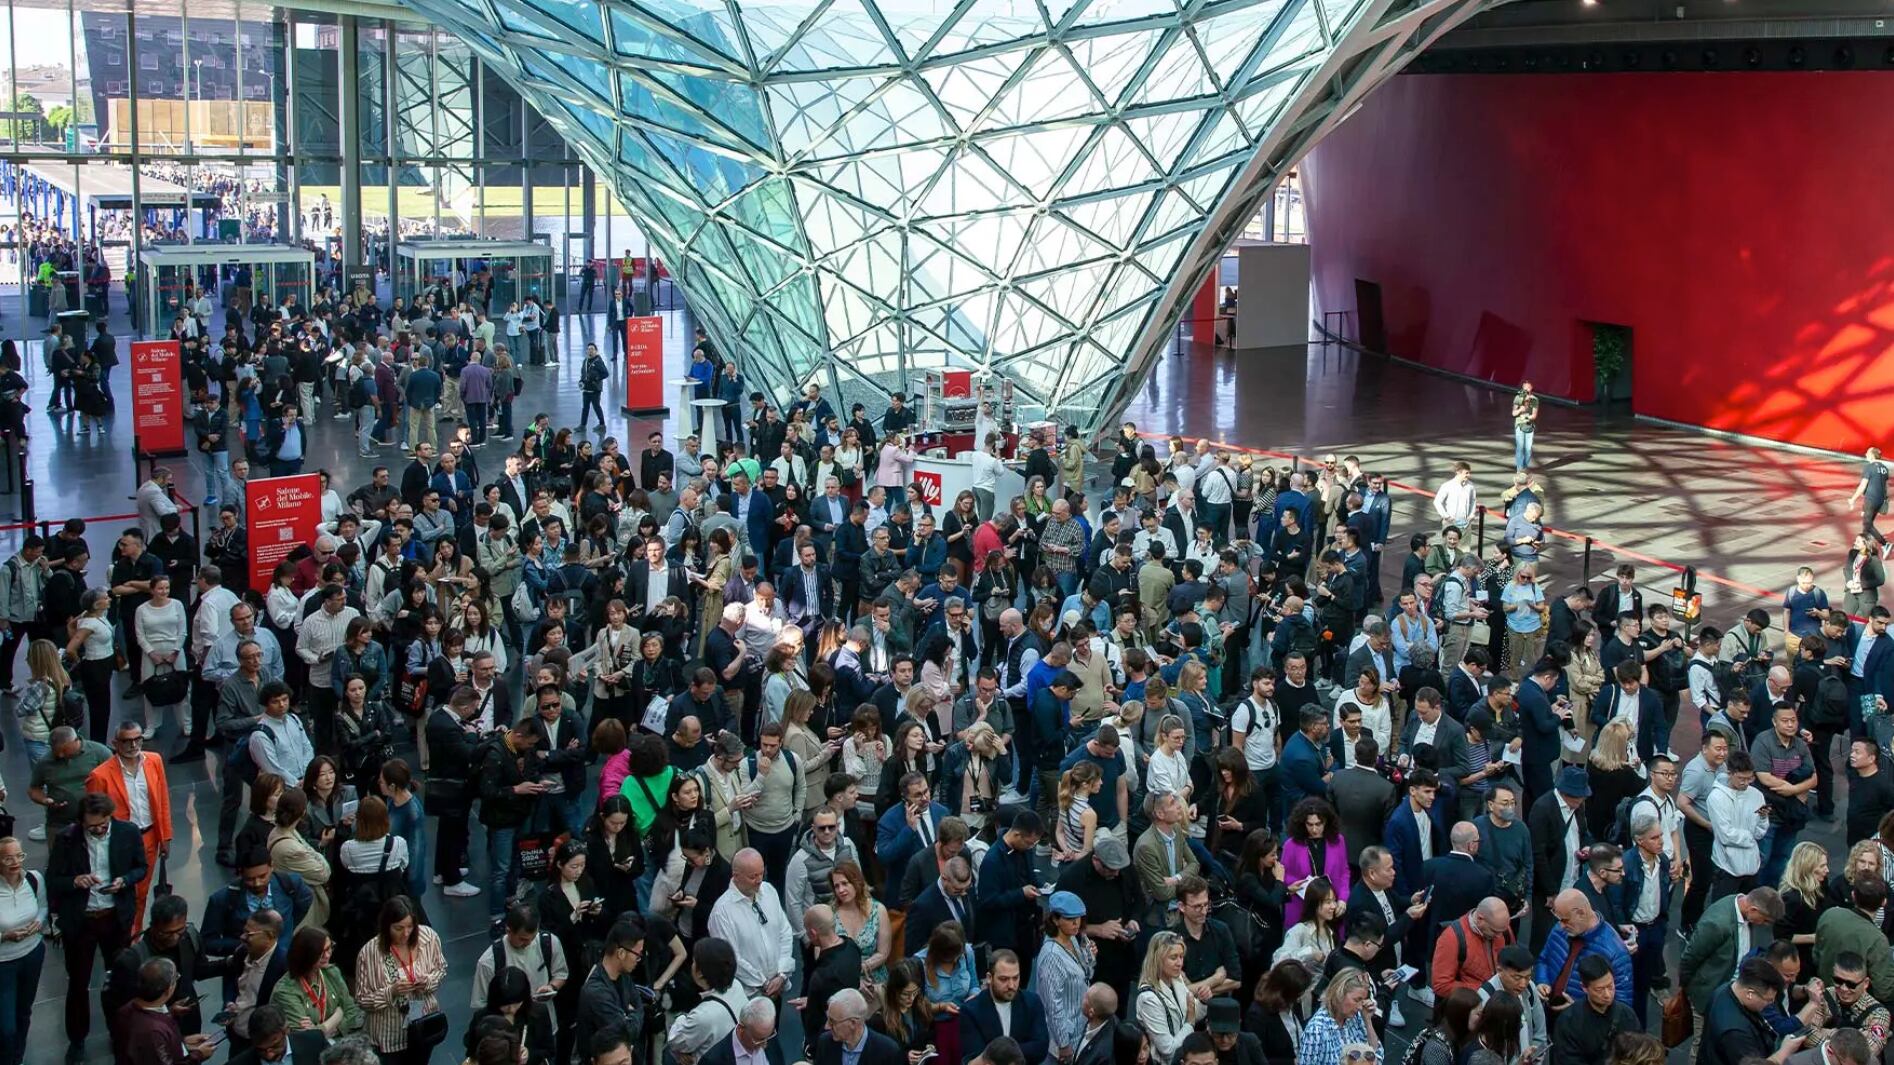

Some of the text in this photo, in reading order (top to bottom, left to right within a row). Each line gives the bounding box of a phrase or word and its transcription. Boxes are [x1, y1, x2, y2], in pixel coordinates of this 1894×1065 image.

[276, 487, 300, 495] Salone
[276, 494, 288, 502] del
[276, 501, 302, 509] Milano
